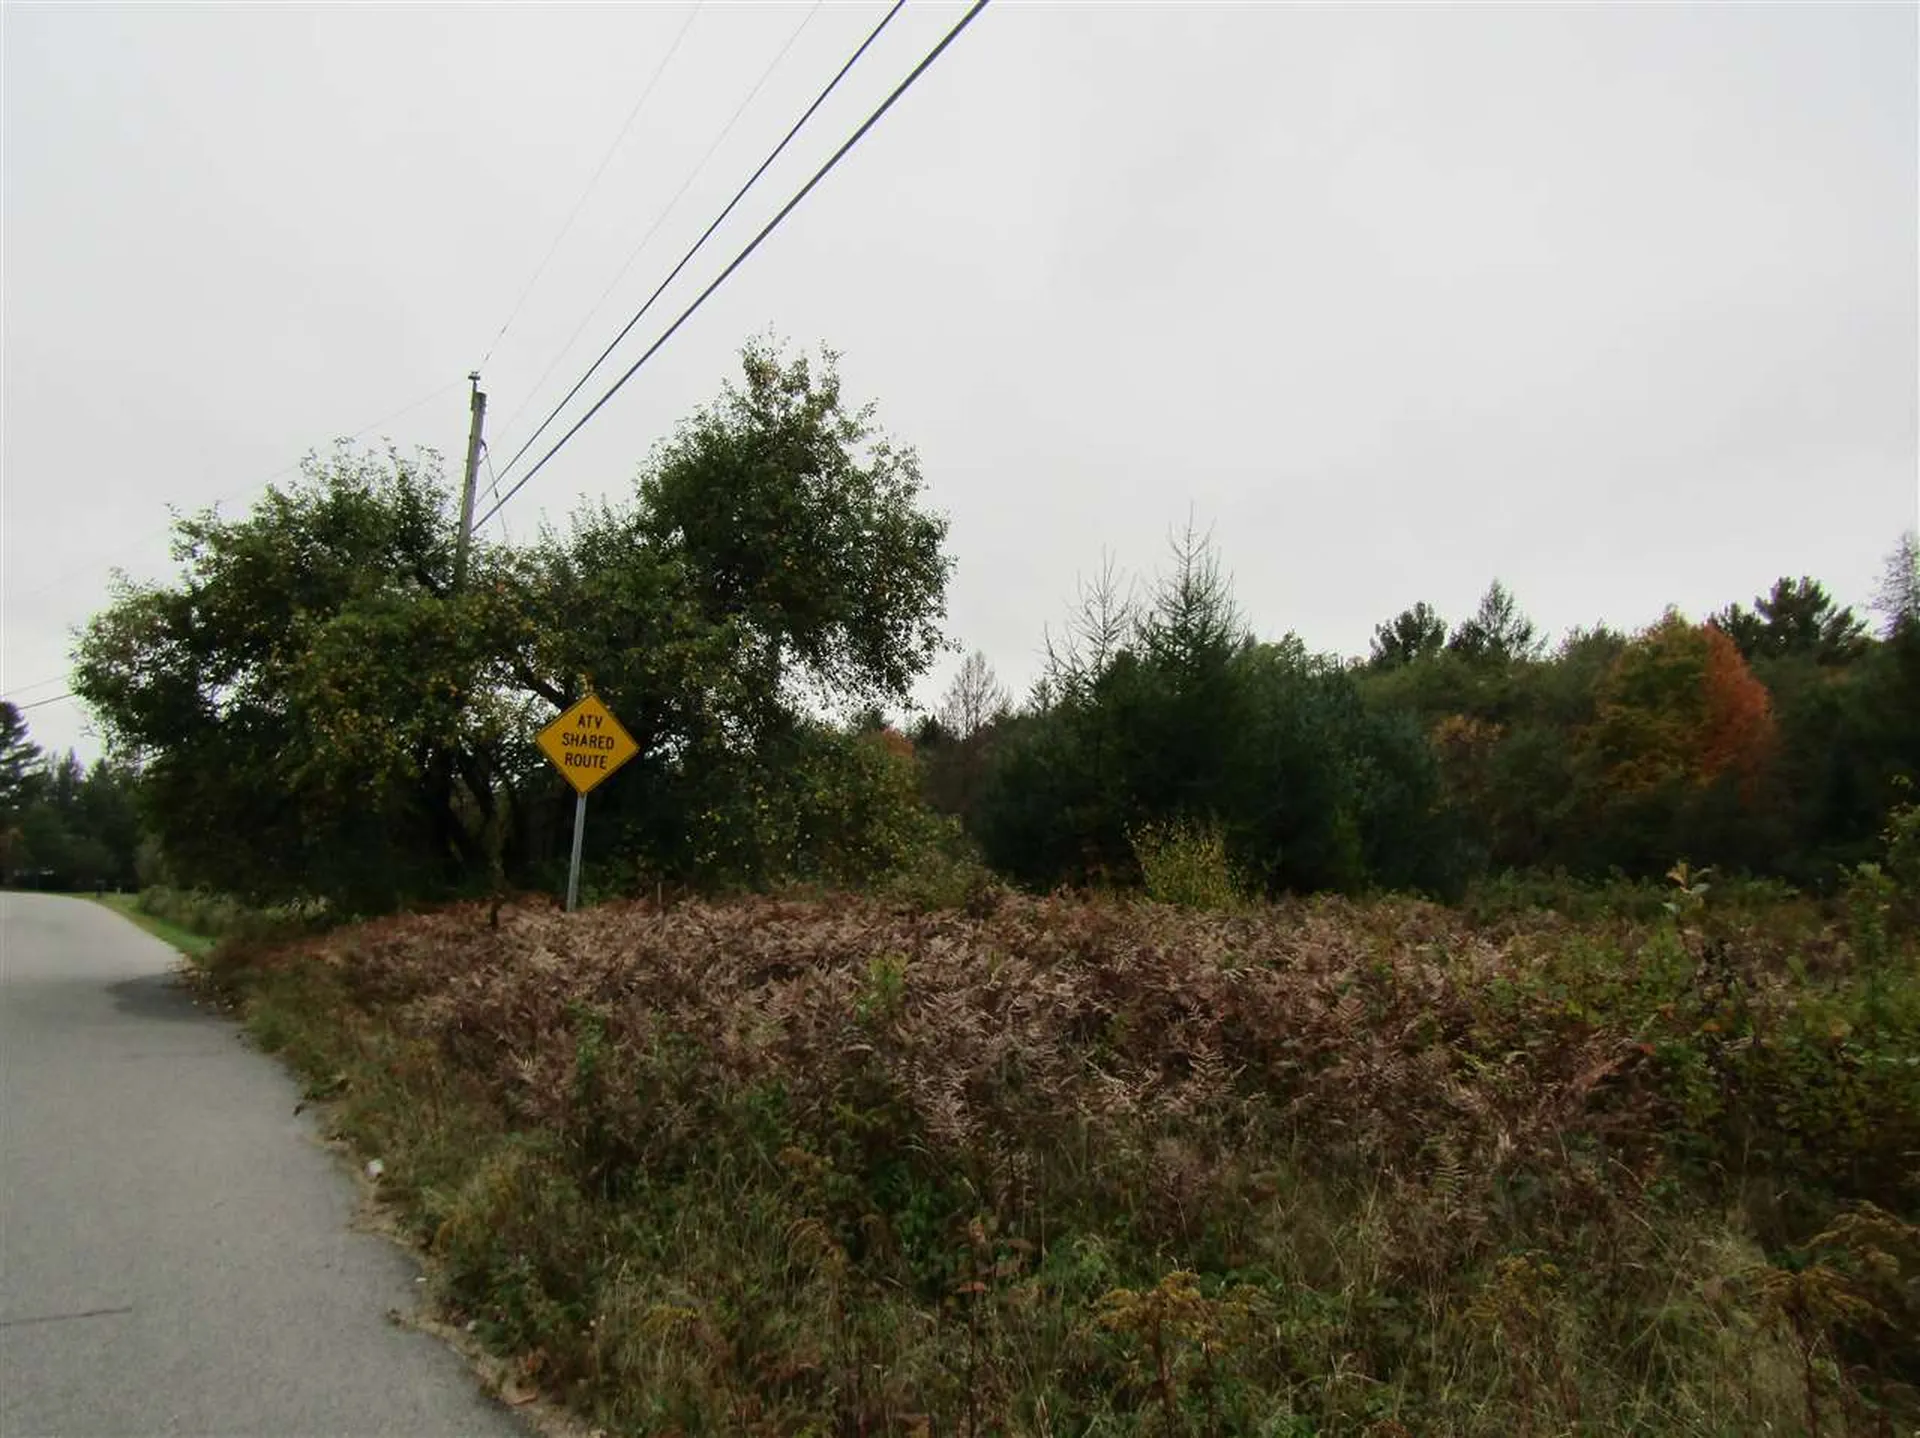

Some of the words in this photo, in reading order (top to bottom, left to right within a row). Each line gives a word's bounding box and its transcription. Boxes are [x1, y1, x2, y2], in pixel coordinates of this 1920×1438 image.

[577, 714, 603, 729] ATV
[562, 732, 615, 750] SHARED
[564, 752, 608, 770] ROUTE
